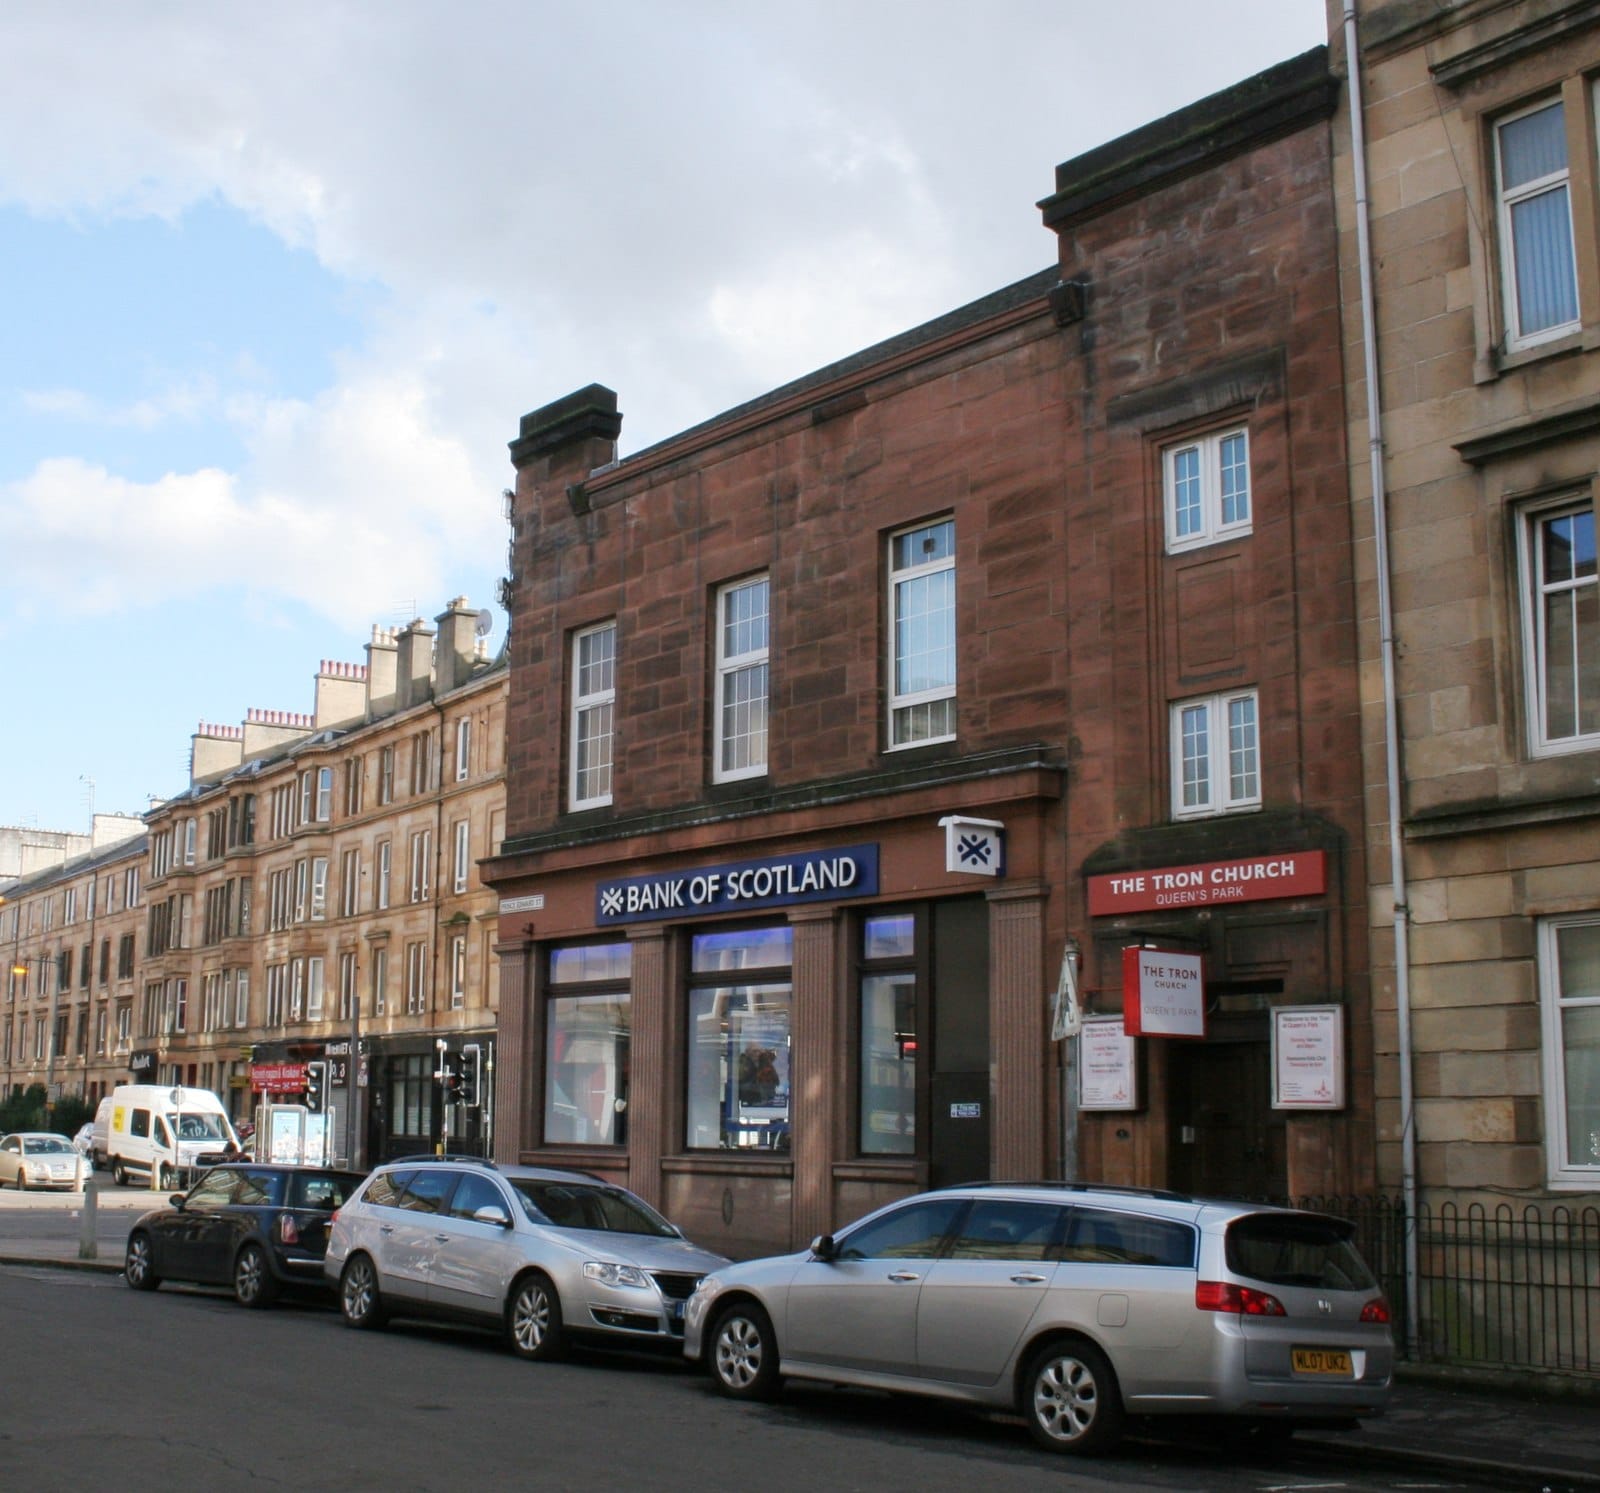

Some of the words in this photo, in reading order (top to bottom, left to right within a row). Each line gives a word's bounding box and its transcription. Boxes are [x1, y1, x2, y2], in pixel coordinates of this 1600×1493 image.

[626, 879, 685, 912] BANK
[689, 874, 720, 904] OF
[727, 856, 857, 900] SCOTLAND
[1110, 877, 1146, 894] THE
[1152, 871, 1204, 890] TRON
[1210, 860, 1296, 884] CHURCH
[1155, 890, 1208, 905] QUEEN'S
[1212, 886, 1244, 899] PARK
[1143, 966, 1165, 978] THE
[1168, 968, 1198, 980] TRON
[1154, 981, 1187, 990] CHURCH
[1144, 1006, 1177, 1017] QUEEN'S
[1178, 1007, 1199, 1017] PARK
